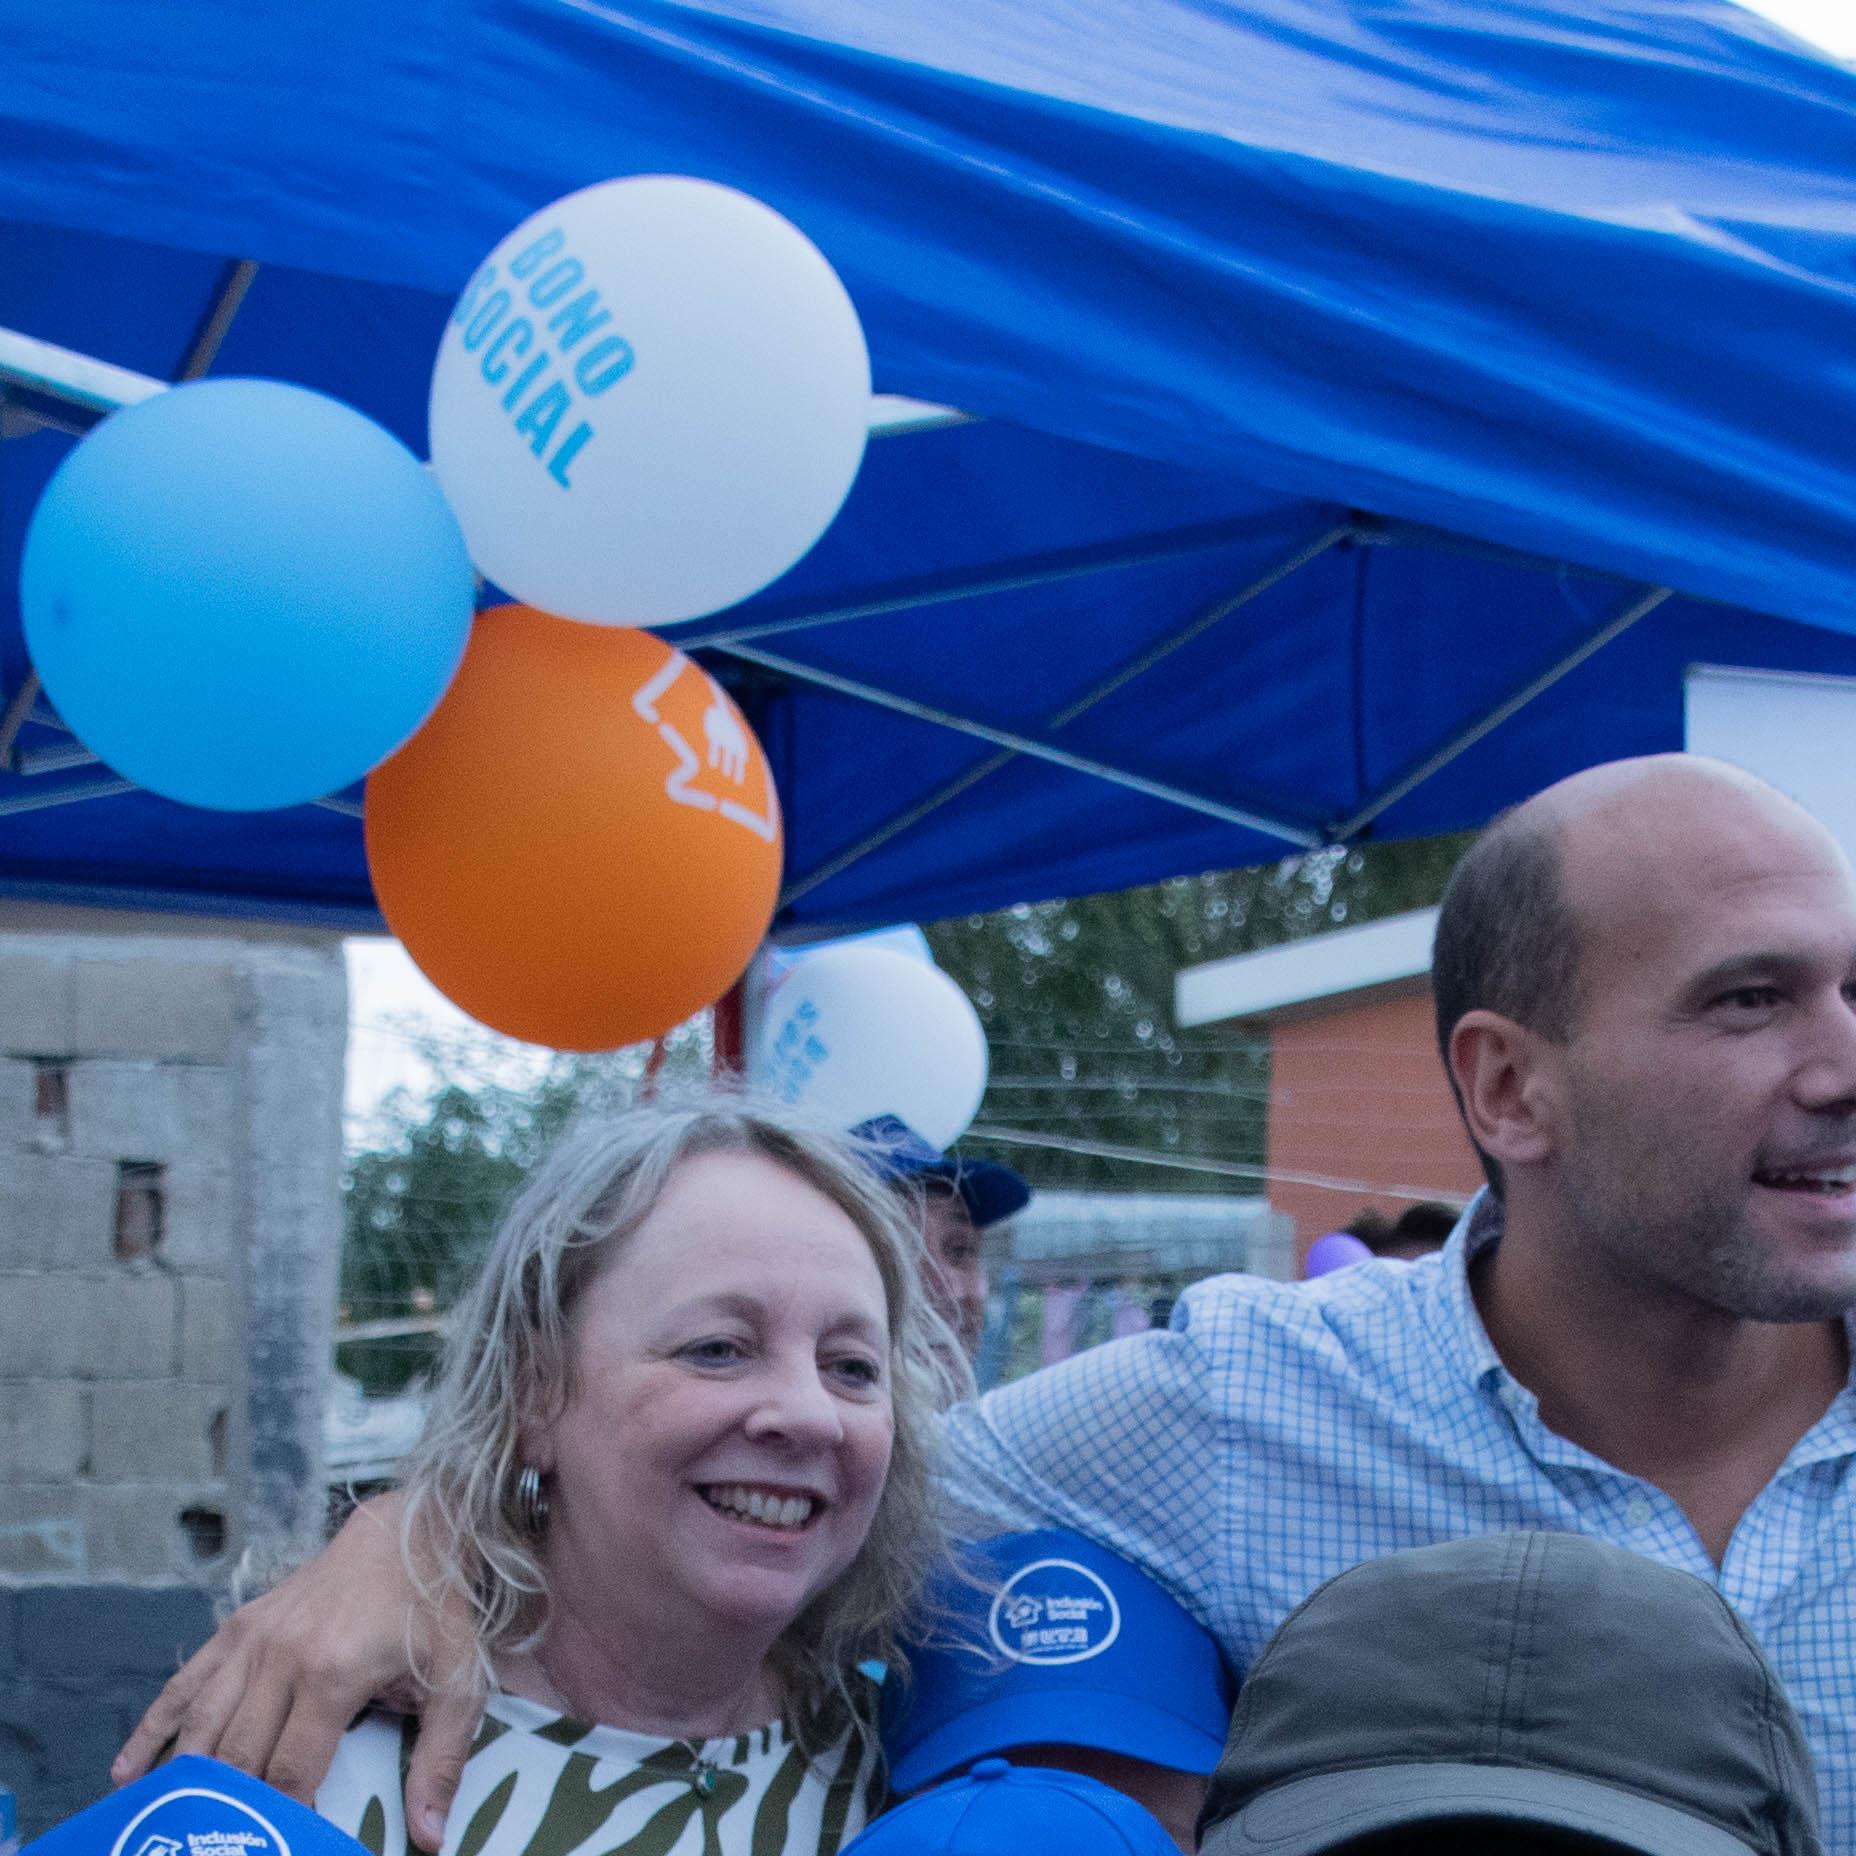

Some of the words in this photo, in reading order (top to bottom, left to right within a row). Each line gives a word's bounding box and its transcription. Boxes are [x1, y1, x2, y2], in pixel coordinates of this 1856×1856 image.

[453, 265, 595, 491] SOCIAL
[508, 226, 635, 397] BONO
[187, 1830, 268, 1848] Inclusión
